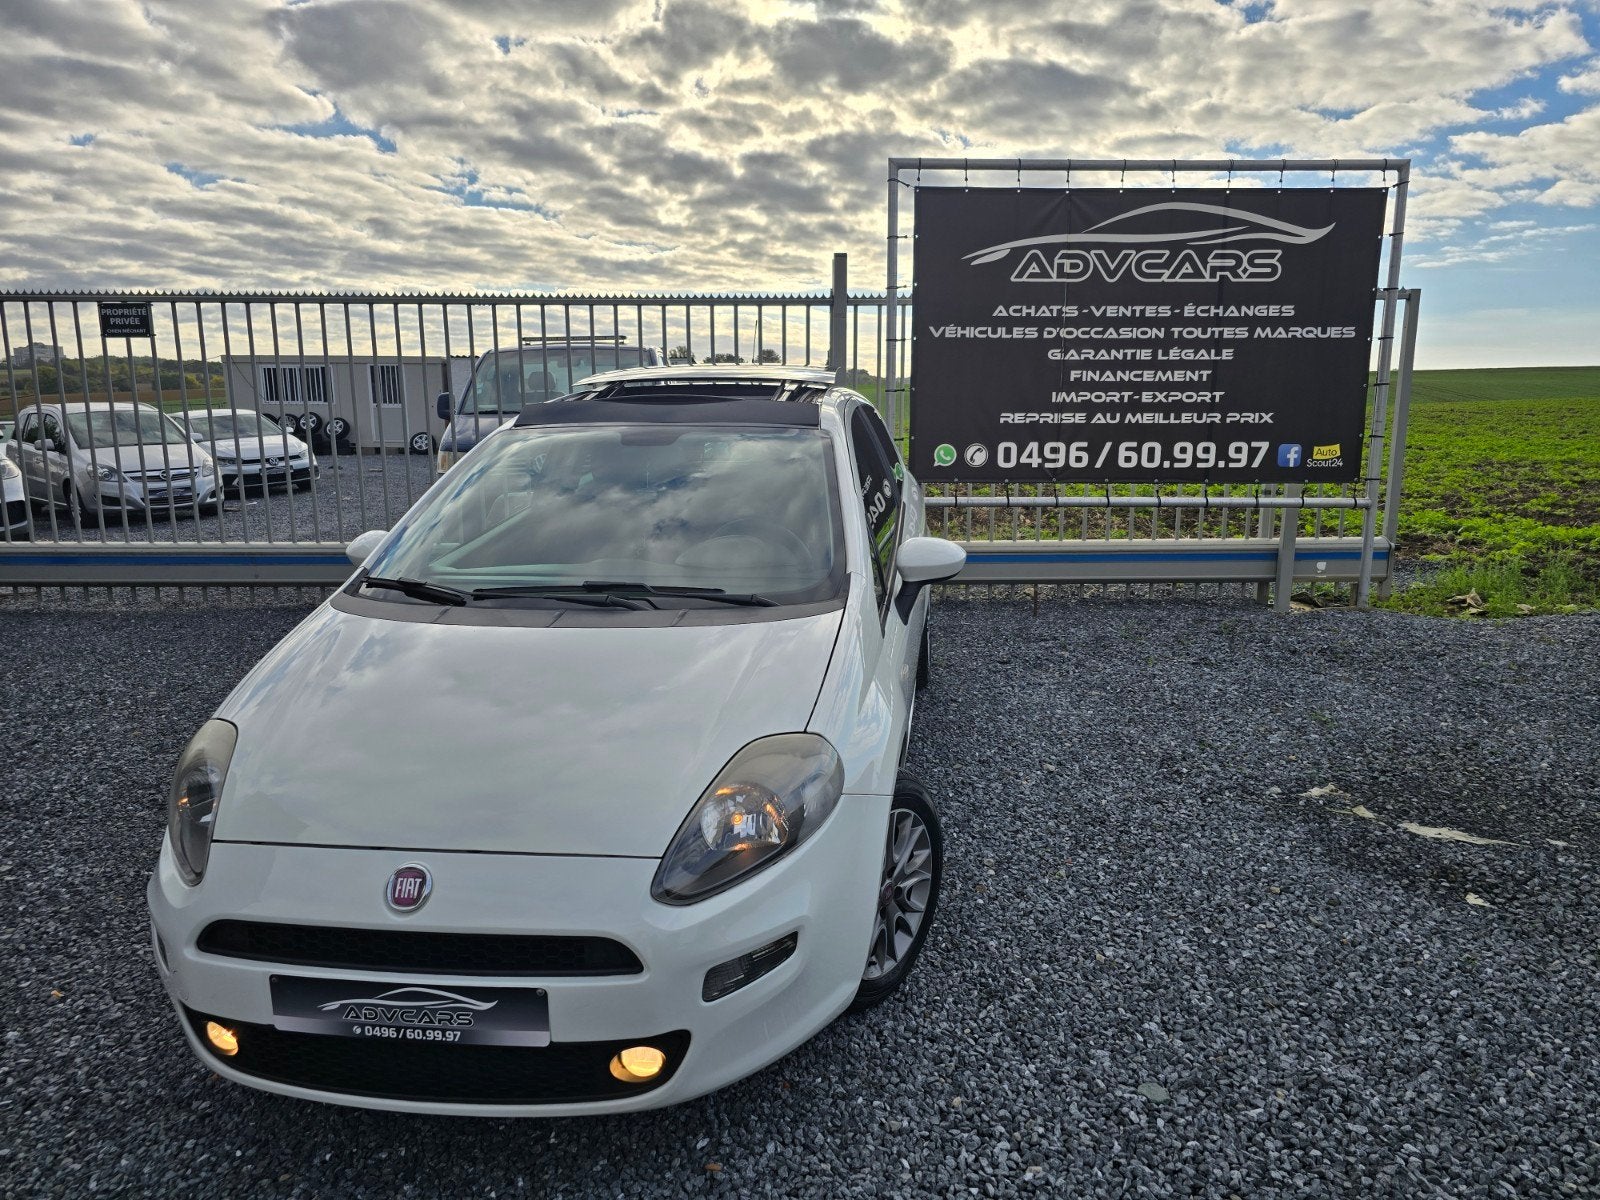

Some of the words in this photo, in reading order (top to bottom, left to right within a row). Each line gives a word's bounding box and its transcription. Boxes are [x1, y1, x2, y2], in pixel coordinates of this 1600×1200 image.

[1010, 249, 1283, 283] ADVCARS
[101, 307, 147, 316] PROPRIÉTÉ
[110, 316, 141, 325] PRIVÉE
[928, 324, 1039, 339] VÉHICULES
[1042, 326, 1165, 340] D'OCCASION
[1169, 326, 1250, 339] TOUTES
[1253, 326, 1357, 339] MARQUES
[1047, 348, 1154, 361] GARANTIE
[1157, 346, 1235, 361] LÉGALE
[1069, 369, 1213, 383] FINANCEMENT
[1051, 391, 1226, 404] IMPORT-EXPORT
[1000, 412, 1087, 425] REPRISE
[1090, 412, 1121, 424] AU
[1124, 412, 1222, 425] MEILLEUR
[1225, 412, 1275, 425] PRIX
[1315, 448, 1338, 457] Auto
[1306, 458, 1344, 468] Scout24
[395, 878, 422, 898] FIAT
[342, 1005, 475, 1028] ADVCARS
